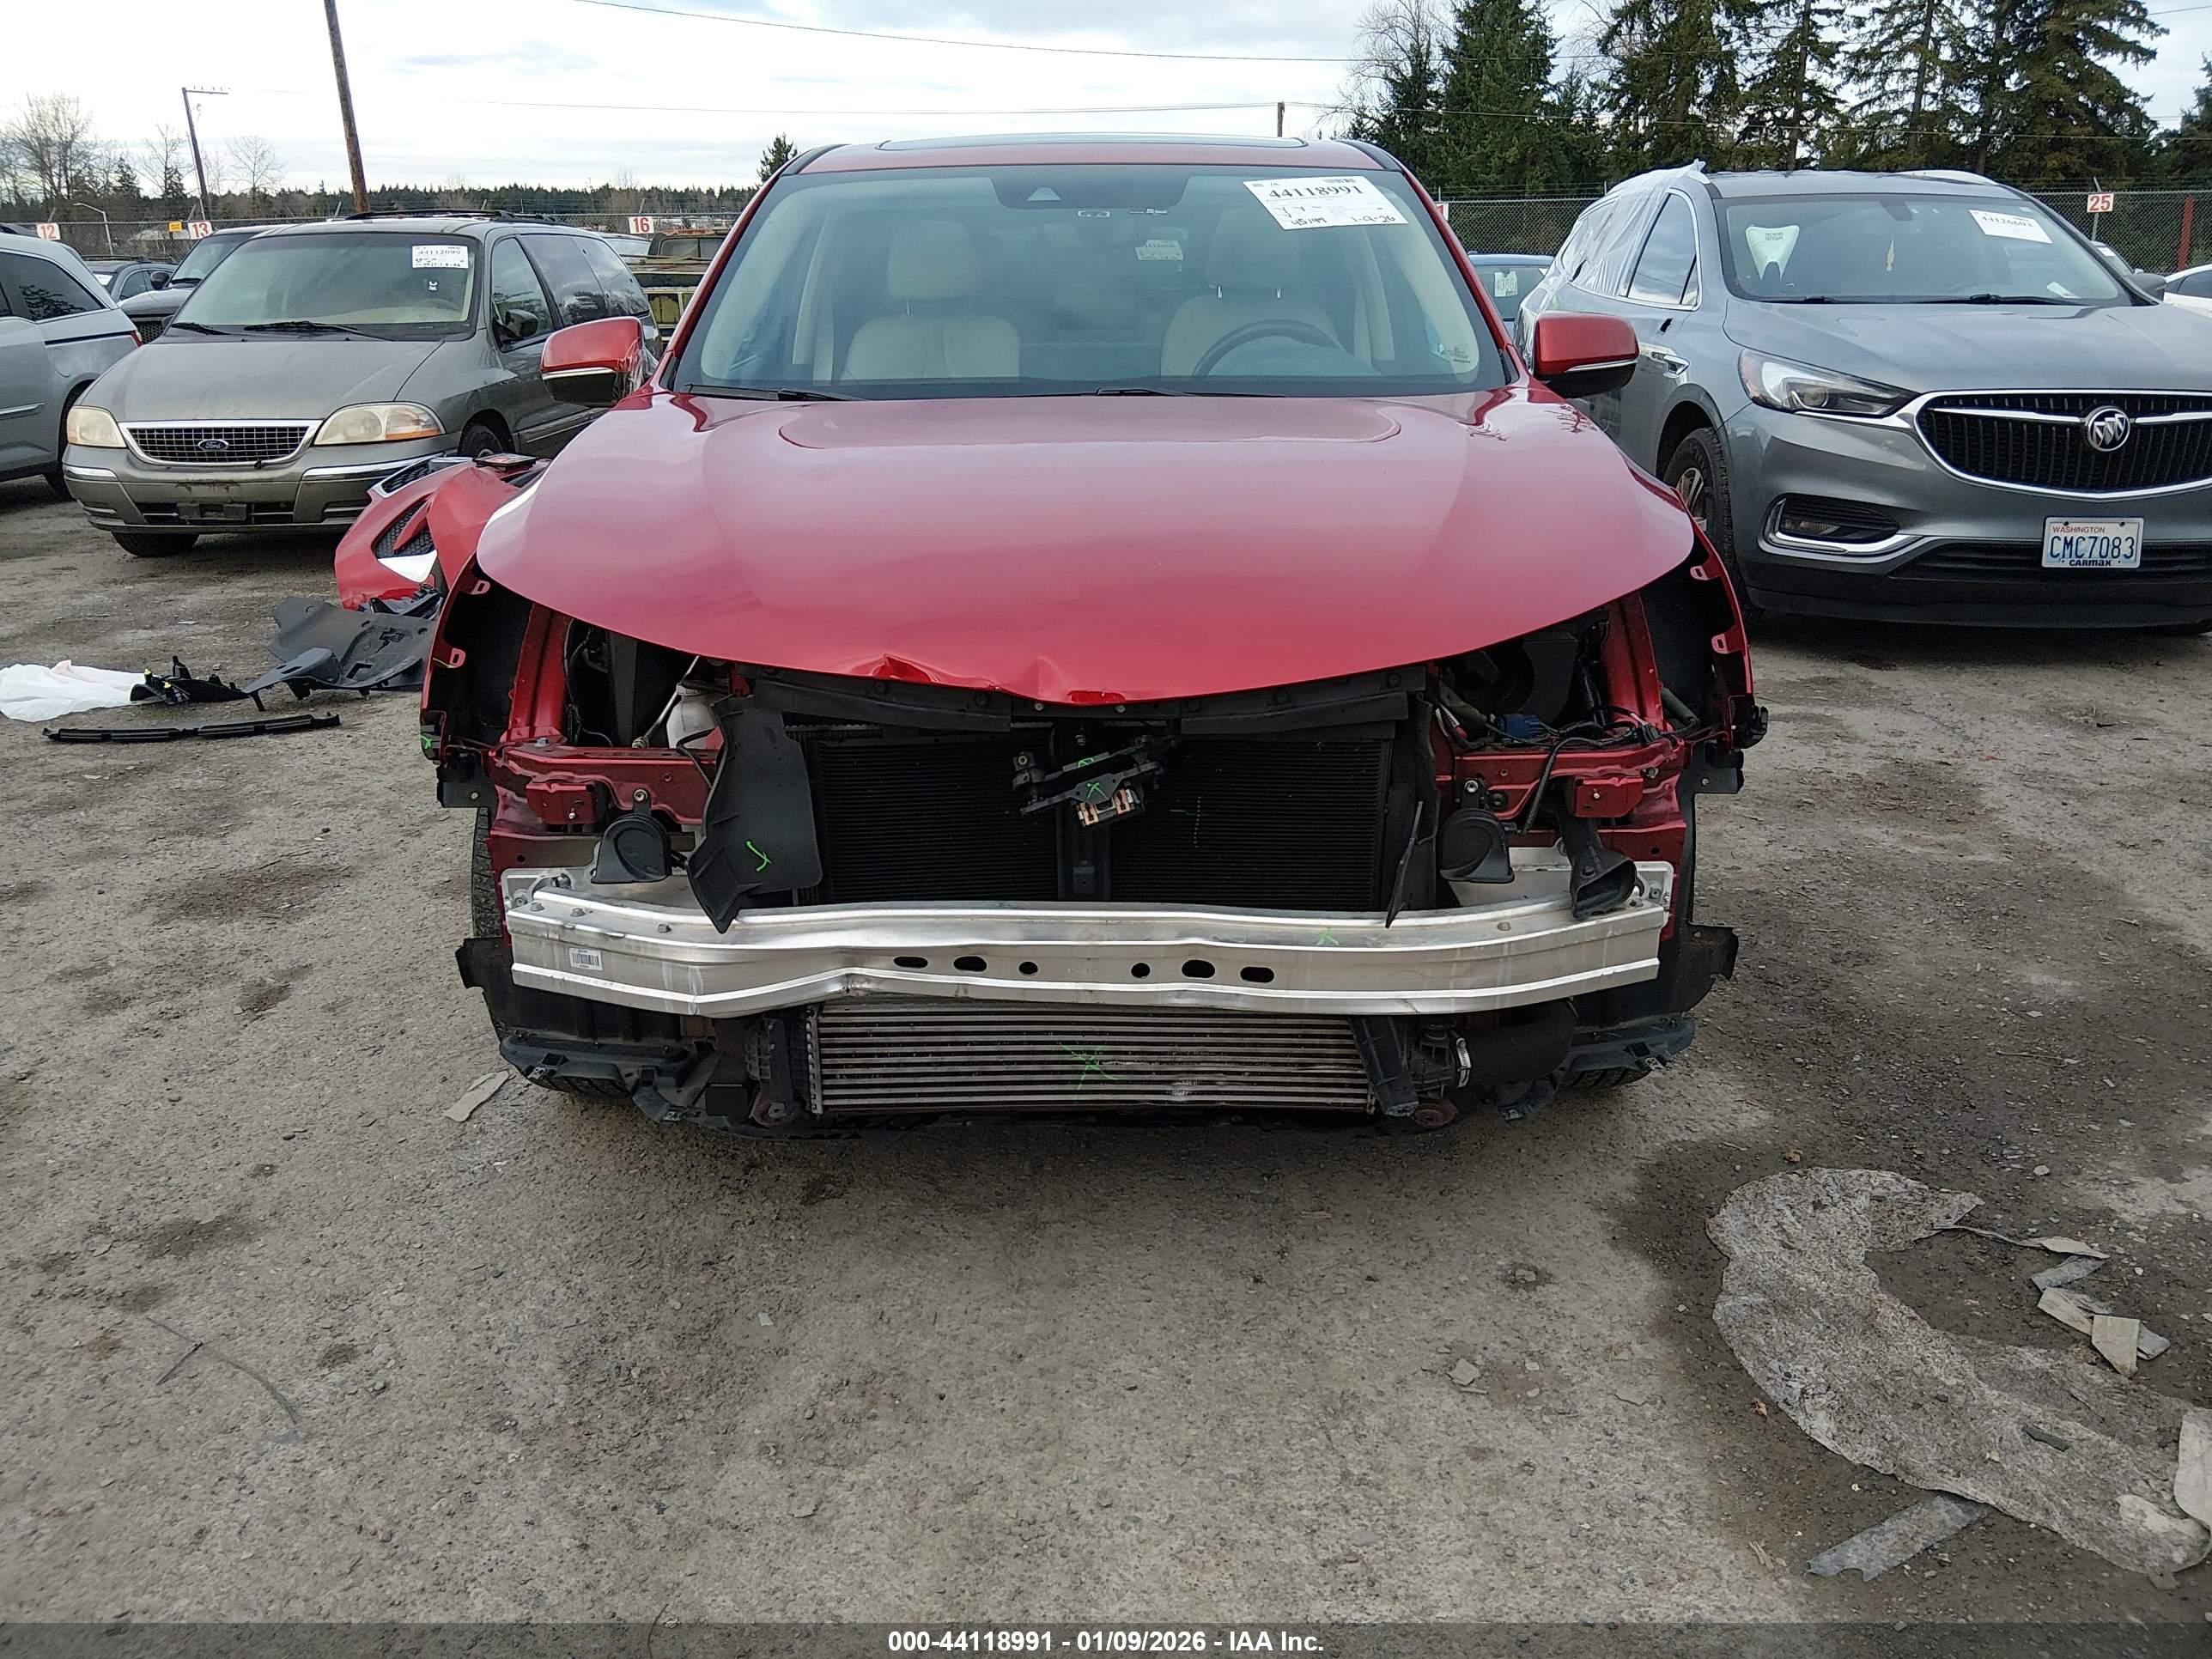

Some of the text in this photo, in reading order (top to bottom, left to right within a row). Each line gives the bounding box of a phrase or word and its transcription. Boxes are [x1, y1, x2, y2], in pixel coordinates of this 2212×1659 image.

[1269, 185, 1364, 198] 44118991
[2089, 195, 2111, 211] 25
[40, 224, 56, 239] 12
[193, 222, 210, 238] 13
[633, 217, 650, 233] 16
[2052, 526, 2106, 534] WASHINGTON
[2050, 536, 2136, 559] CMC7083
